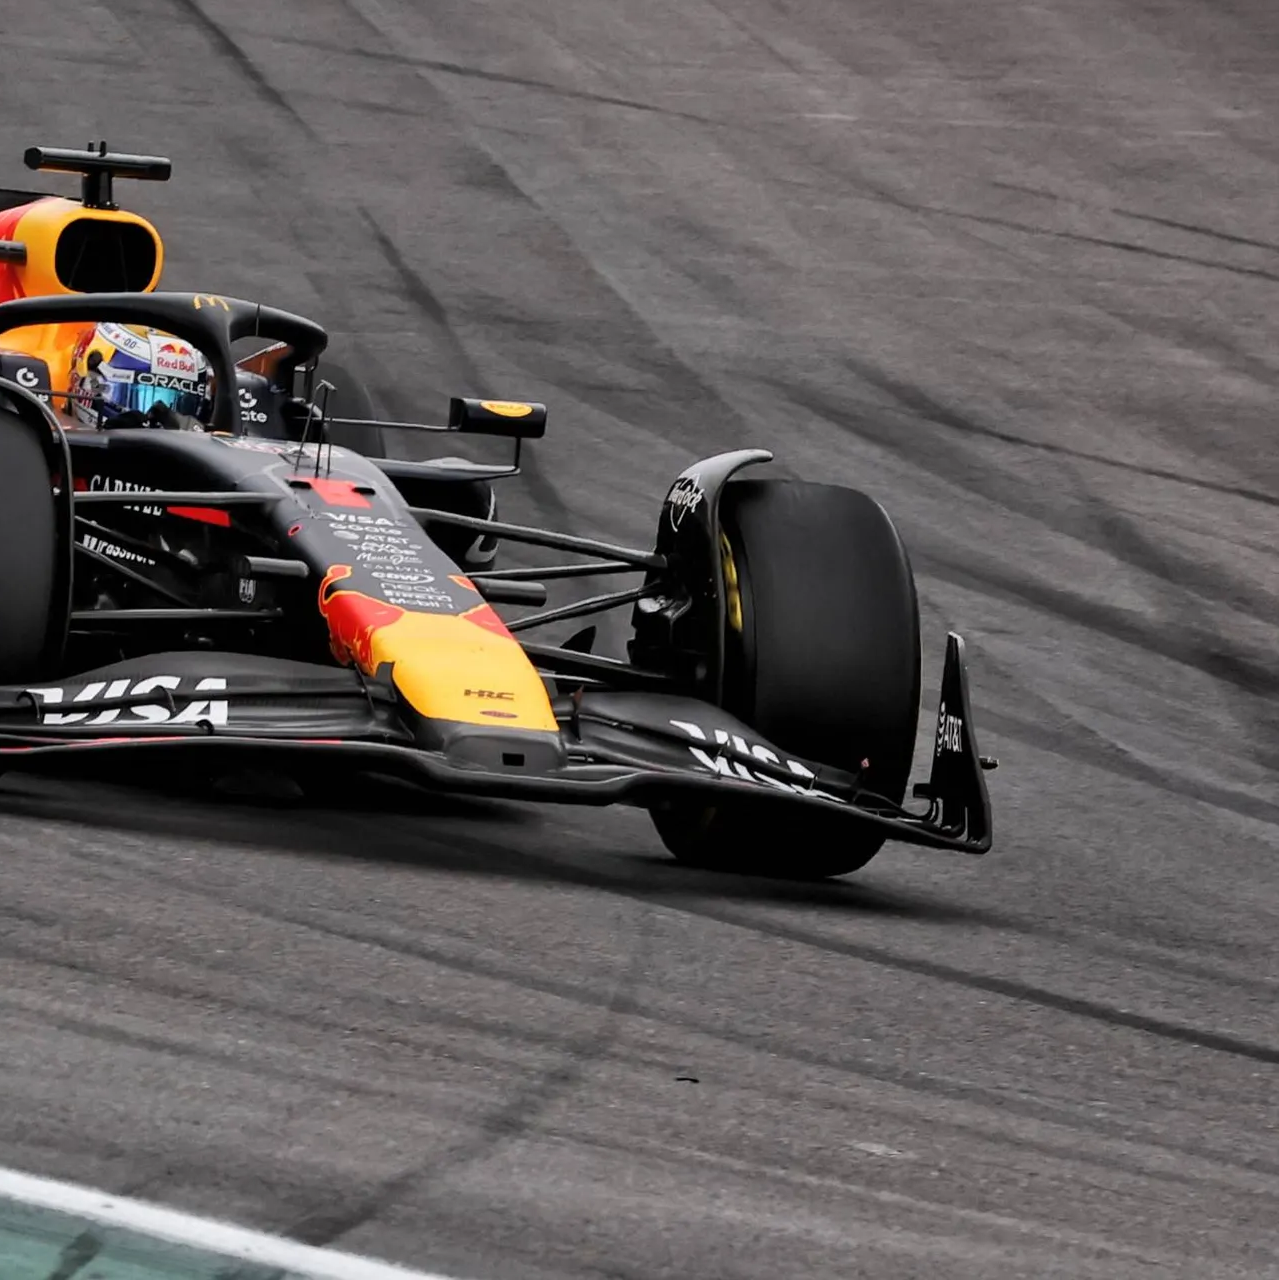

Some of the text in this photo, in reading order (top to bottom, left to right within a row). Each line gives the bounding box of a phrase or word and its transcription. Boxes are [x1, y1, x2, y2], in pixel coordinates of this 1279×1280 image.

[156, 356, 177, 371] Red
[136, 372, 207, 398] ORACLE
[241, 410, 269, 424] ate
[321, 511, 396, 526] VISA
[25, 676, 230, 726] VISA
[463, 688, 516, 702] HRC
[942, 714, 964, 753] AT&T
